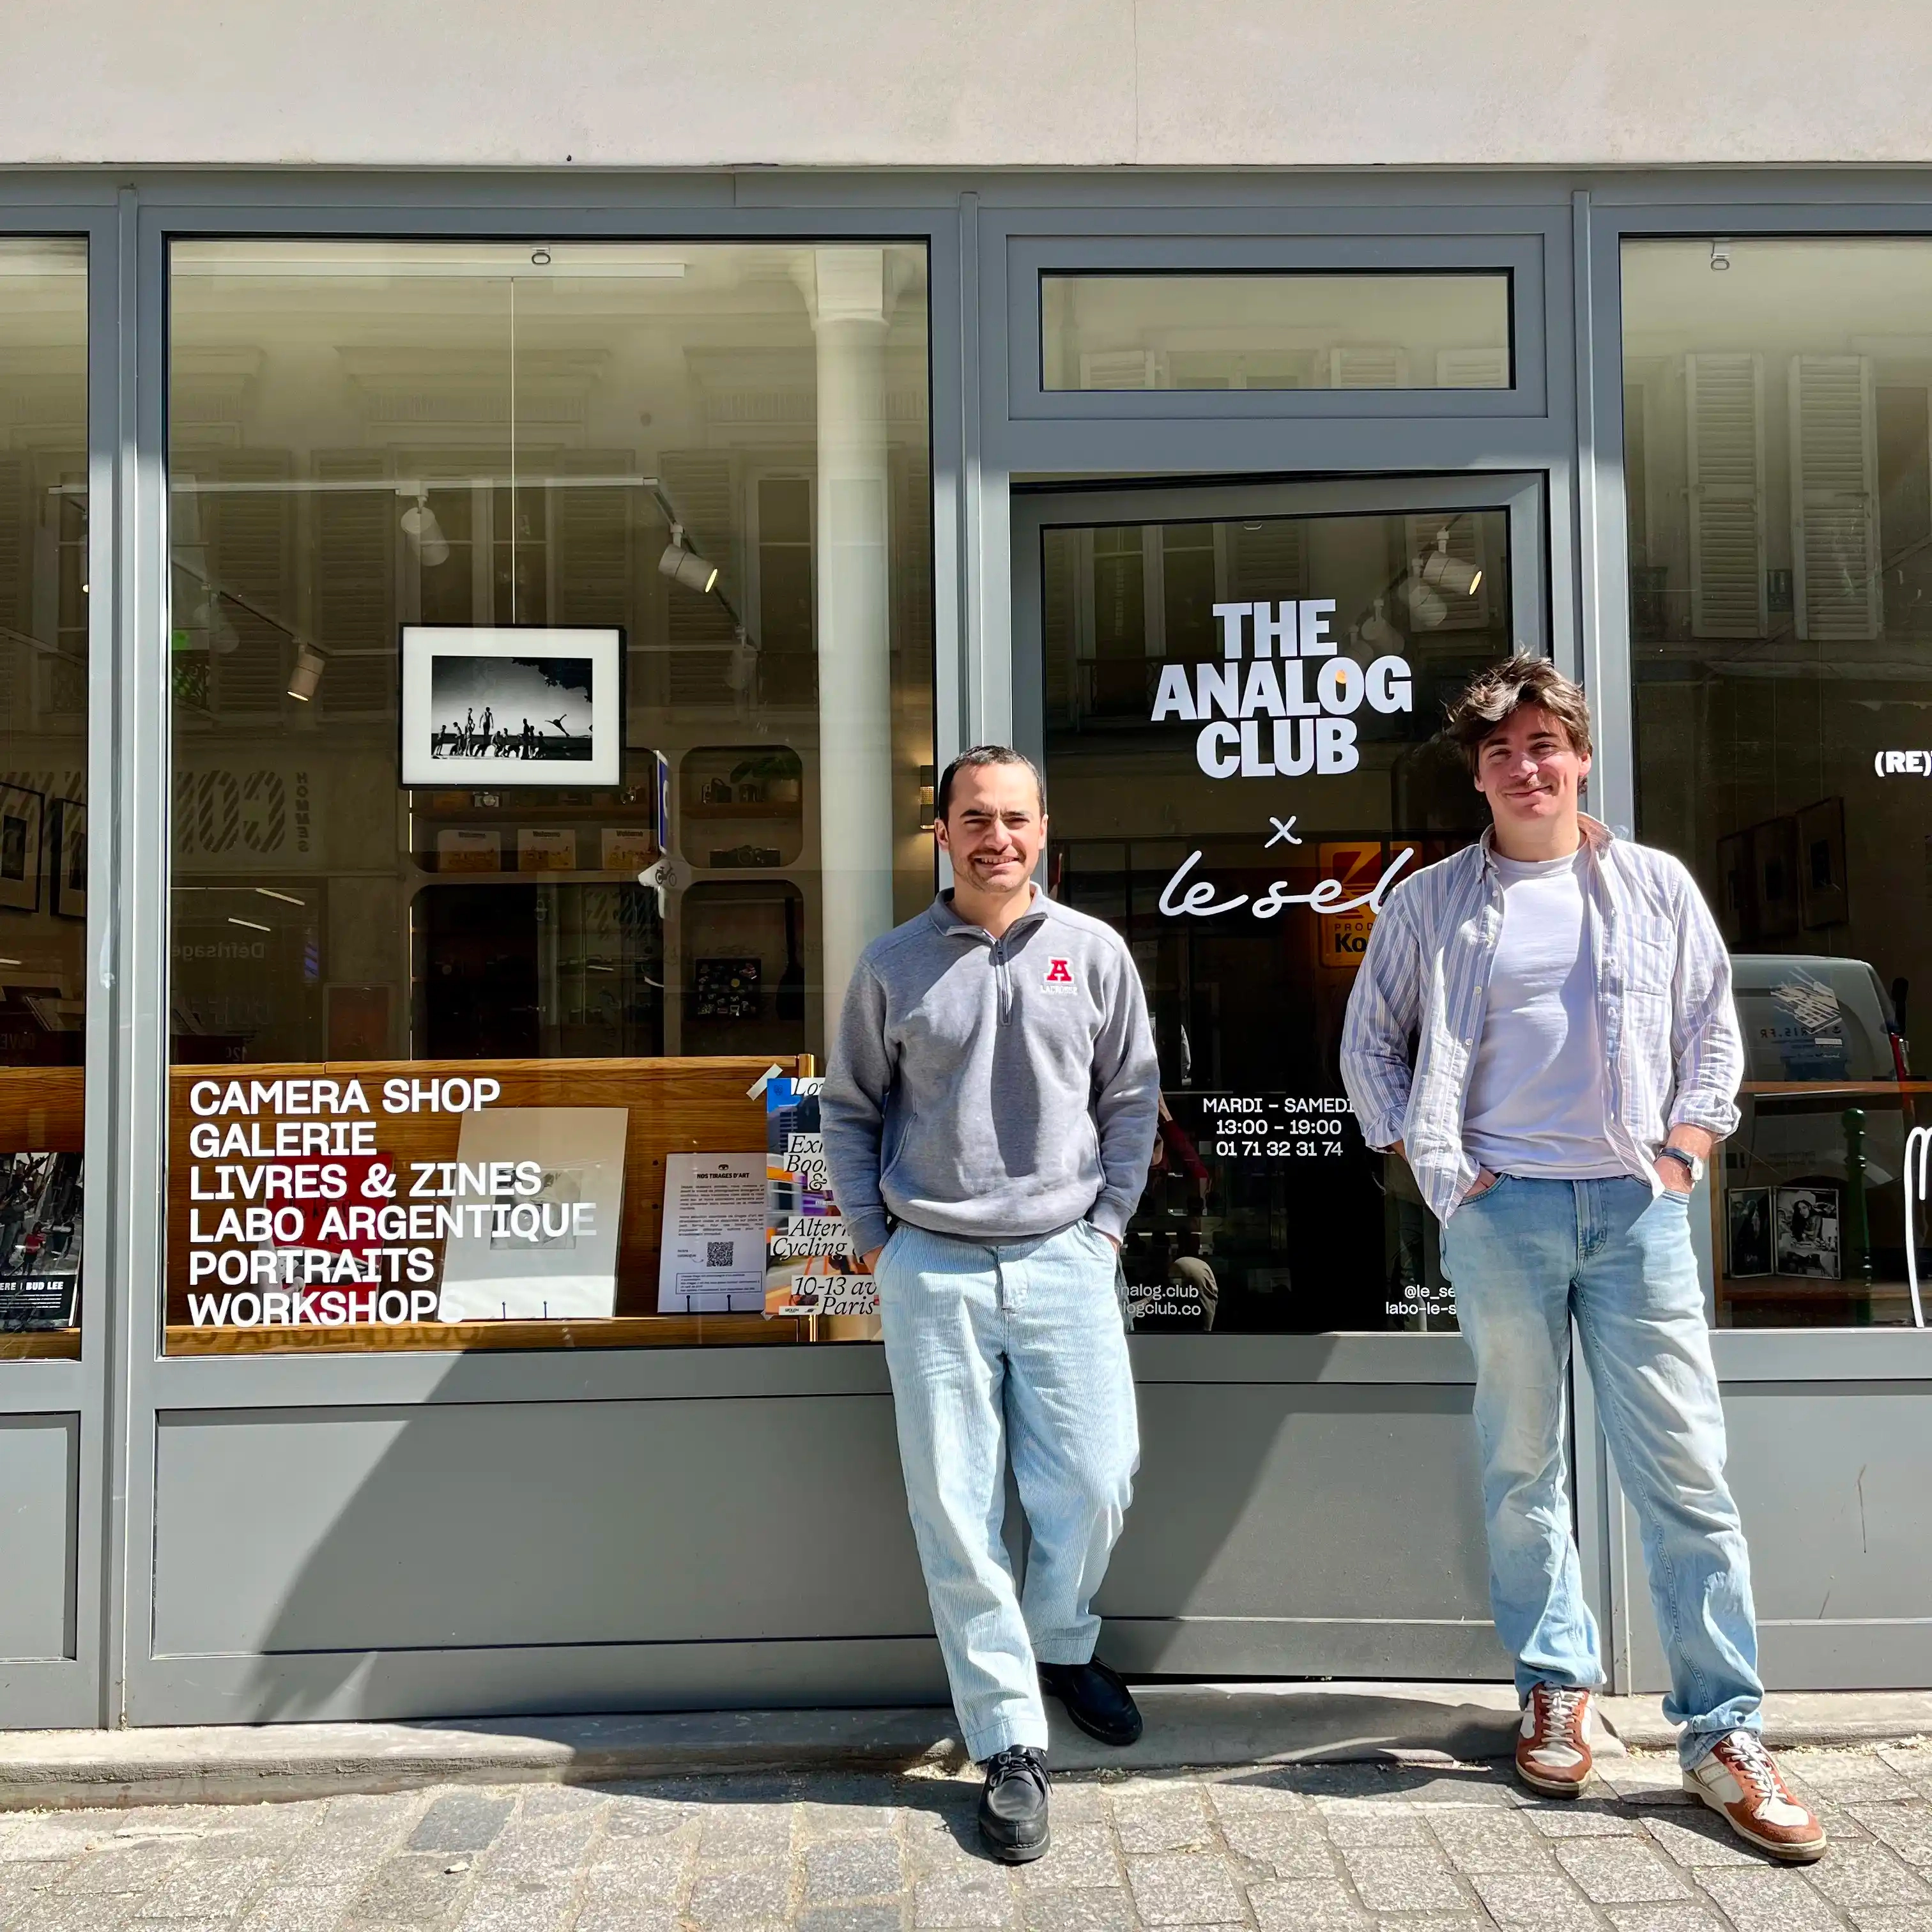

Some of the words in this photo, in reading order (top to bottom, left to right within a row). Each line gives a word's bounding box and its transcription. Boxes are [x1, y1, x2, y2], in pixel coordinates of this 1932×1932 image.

[1213, 599, 1338, 659] THE
[1151, 656, 1413, 721] ANALOG
[1197, 718, 1360, 779] CLUB
[1874, 751, 1932, 778] (RE)
[1159, 850, 1248, 917] le
[1045, 958, 1073, 983] A
[190, 1079, 370, 1116] CAMERA
[381, 1078, 500, 1113] SHOP
[1202, 1098, 1263, 1113] MARDI
[190, 1121, 378, 1159] GALERIE
[1216, 1120, 1268, 1135] 13:00
[1290, 1119, 1342, 1135] 19:00
[1216, 1141, 1238, 1156] 01
[1241, 1141, 1262, 1156] 71
[1266, 1141, 1291, 1156] 32
[1296, 1141, 1317, 1156] 31
[1322, 1141, 1344, 1156] 74
[786, 1154, 827, 1172] Boo
[190, 1163, 347, 1200] LIVRES
[360, 1162, 397, 1198] &
[408, 1161, 542, 1197] ZINES
[809, 1173, 827, 1191] &
[190, 1206, 305, 1243] LABO
[318, 1202, 597, 1241] ARGENTIQUE
[772, 1237, 848, 1261] Cycling
[190, 1246, 434, 1286] PORTRAITS
[26, 1282, 45, 1291] BUD
[47, 1281, 64, 1290] LEE
[795, 1276, 847, 1296] 10-13
[822, 1296, 876, 1315] Paris
